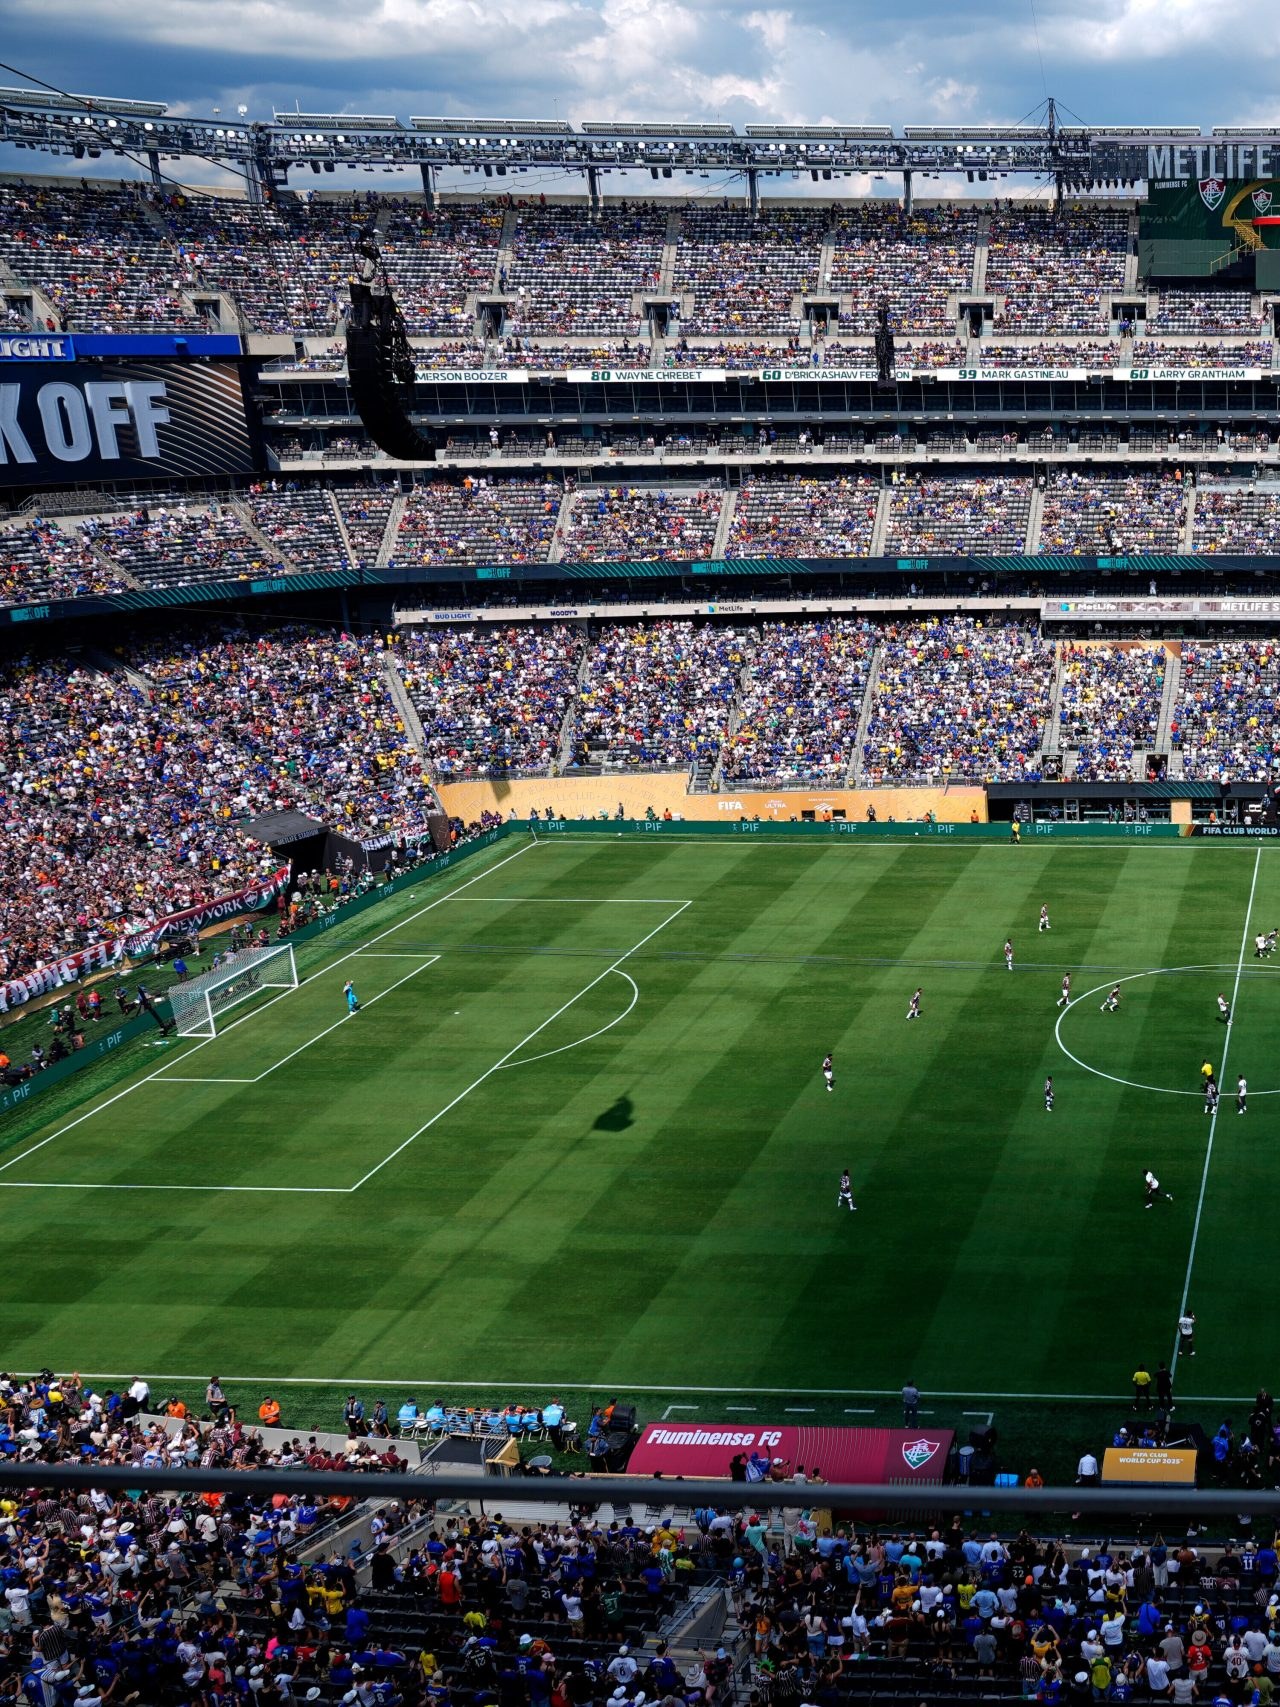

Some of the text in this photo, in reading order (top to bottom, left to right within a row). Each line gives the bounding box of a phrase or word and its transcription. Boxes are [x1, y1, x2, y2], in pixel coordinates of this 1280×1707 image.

[1148, 145, 1273, 179] METLIFE
[415, 372, 508, 381] MERSON BOOZER
[591, 371, 702, 381] 80 WAYNE CHREBET
[762, 370, 910, 380] 60 D'BRICKASHAW FERON
[958, 369, 1068, 379] 99 MARK GASTINEAU
[1130, 369, 1245, 379] 60 LARRY GRANTHAM
[37, 380, 170, 462] OFF
[1221, 602, 1269, 611] METLIFE
[718, 801, 743, 810] FIFA
[548, 821, 565, 831] PIF
[645, 822, 662, 832] PIF
[741, 823, 759, 832] PIF
[839, 823, 857, 833] PIF
[937, 824, 955, 834] PIF
[1036, 825, 1053, 834] PIF
[1135, 825, 1152, 835] PIF
[1203, 826, 1221, 835] FIFA
[1222, 826, 1244, 835] CLUB
[1246, 827, 1277, 835] WORLD
[489, 830, 499, 841] PIF
[439, 857, 450, 868] PIF
[383, 884, 394, 896] PIF
[205, 898, 243, 919] YORK
[324, 913, 336, 925] PIF
[106, 1031, 123, 1048] PIF
[13, 1084, 31, 1103] PIF
[647, 1429, 782, 1447] Fluminense FC
